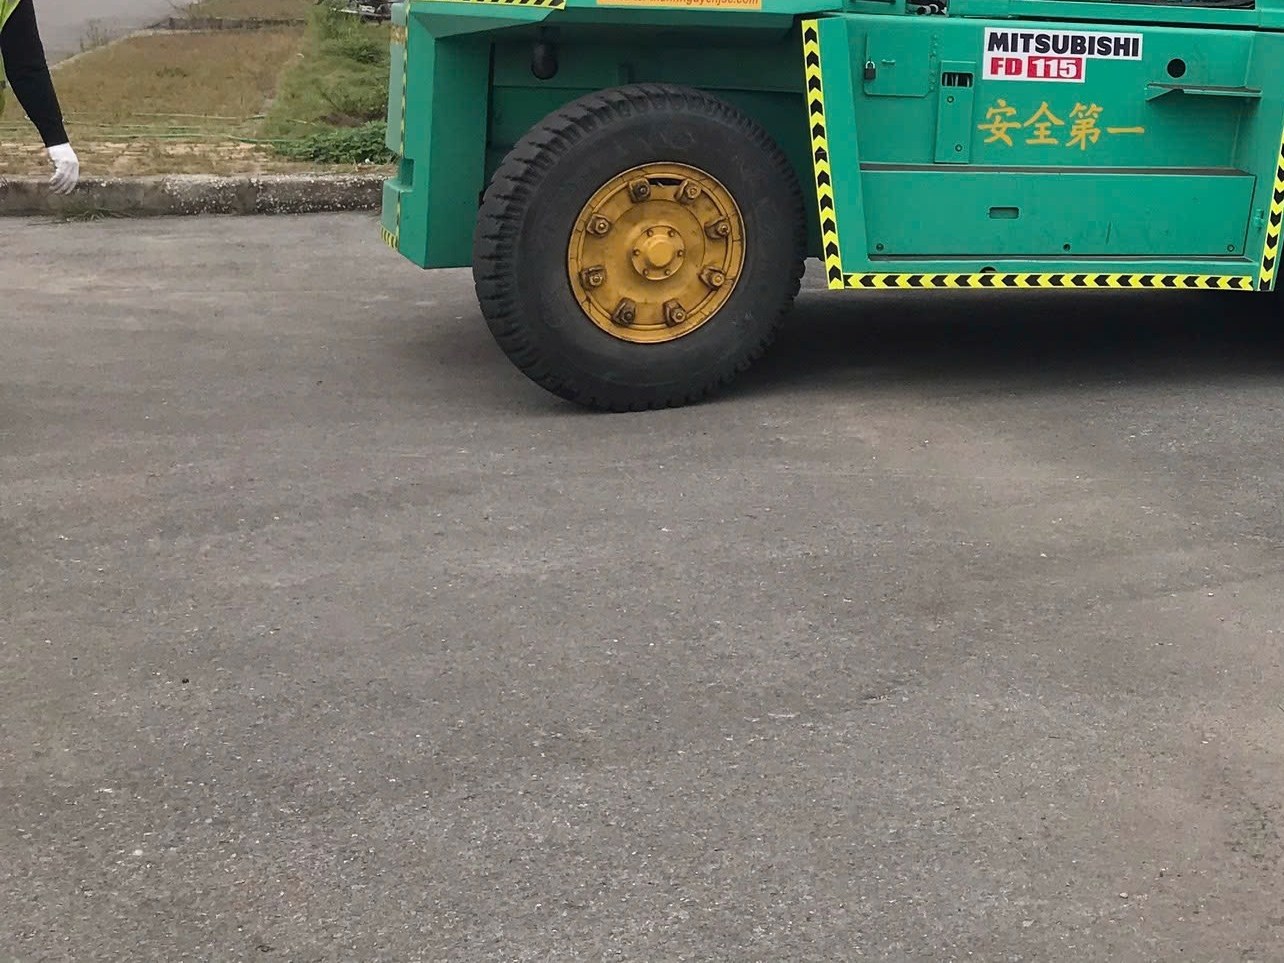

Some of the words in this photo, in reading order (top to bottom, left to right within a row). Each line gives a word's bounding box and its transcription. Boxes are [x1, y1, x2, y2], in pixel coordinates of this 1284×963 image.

[987, 32, 1140, 57] MITSUBISHI
[990, 57, 1023, 76] FD
[1031, 57, 1078, 79] 115
[977, 98, 1145, 151] 安全第一
